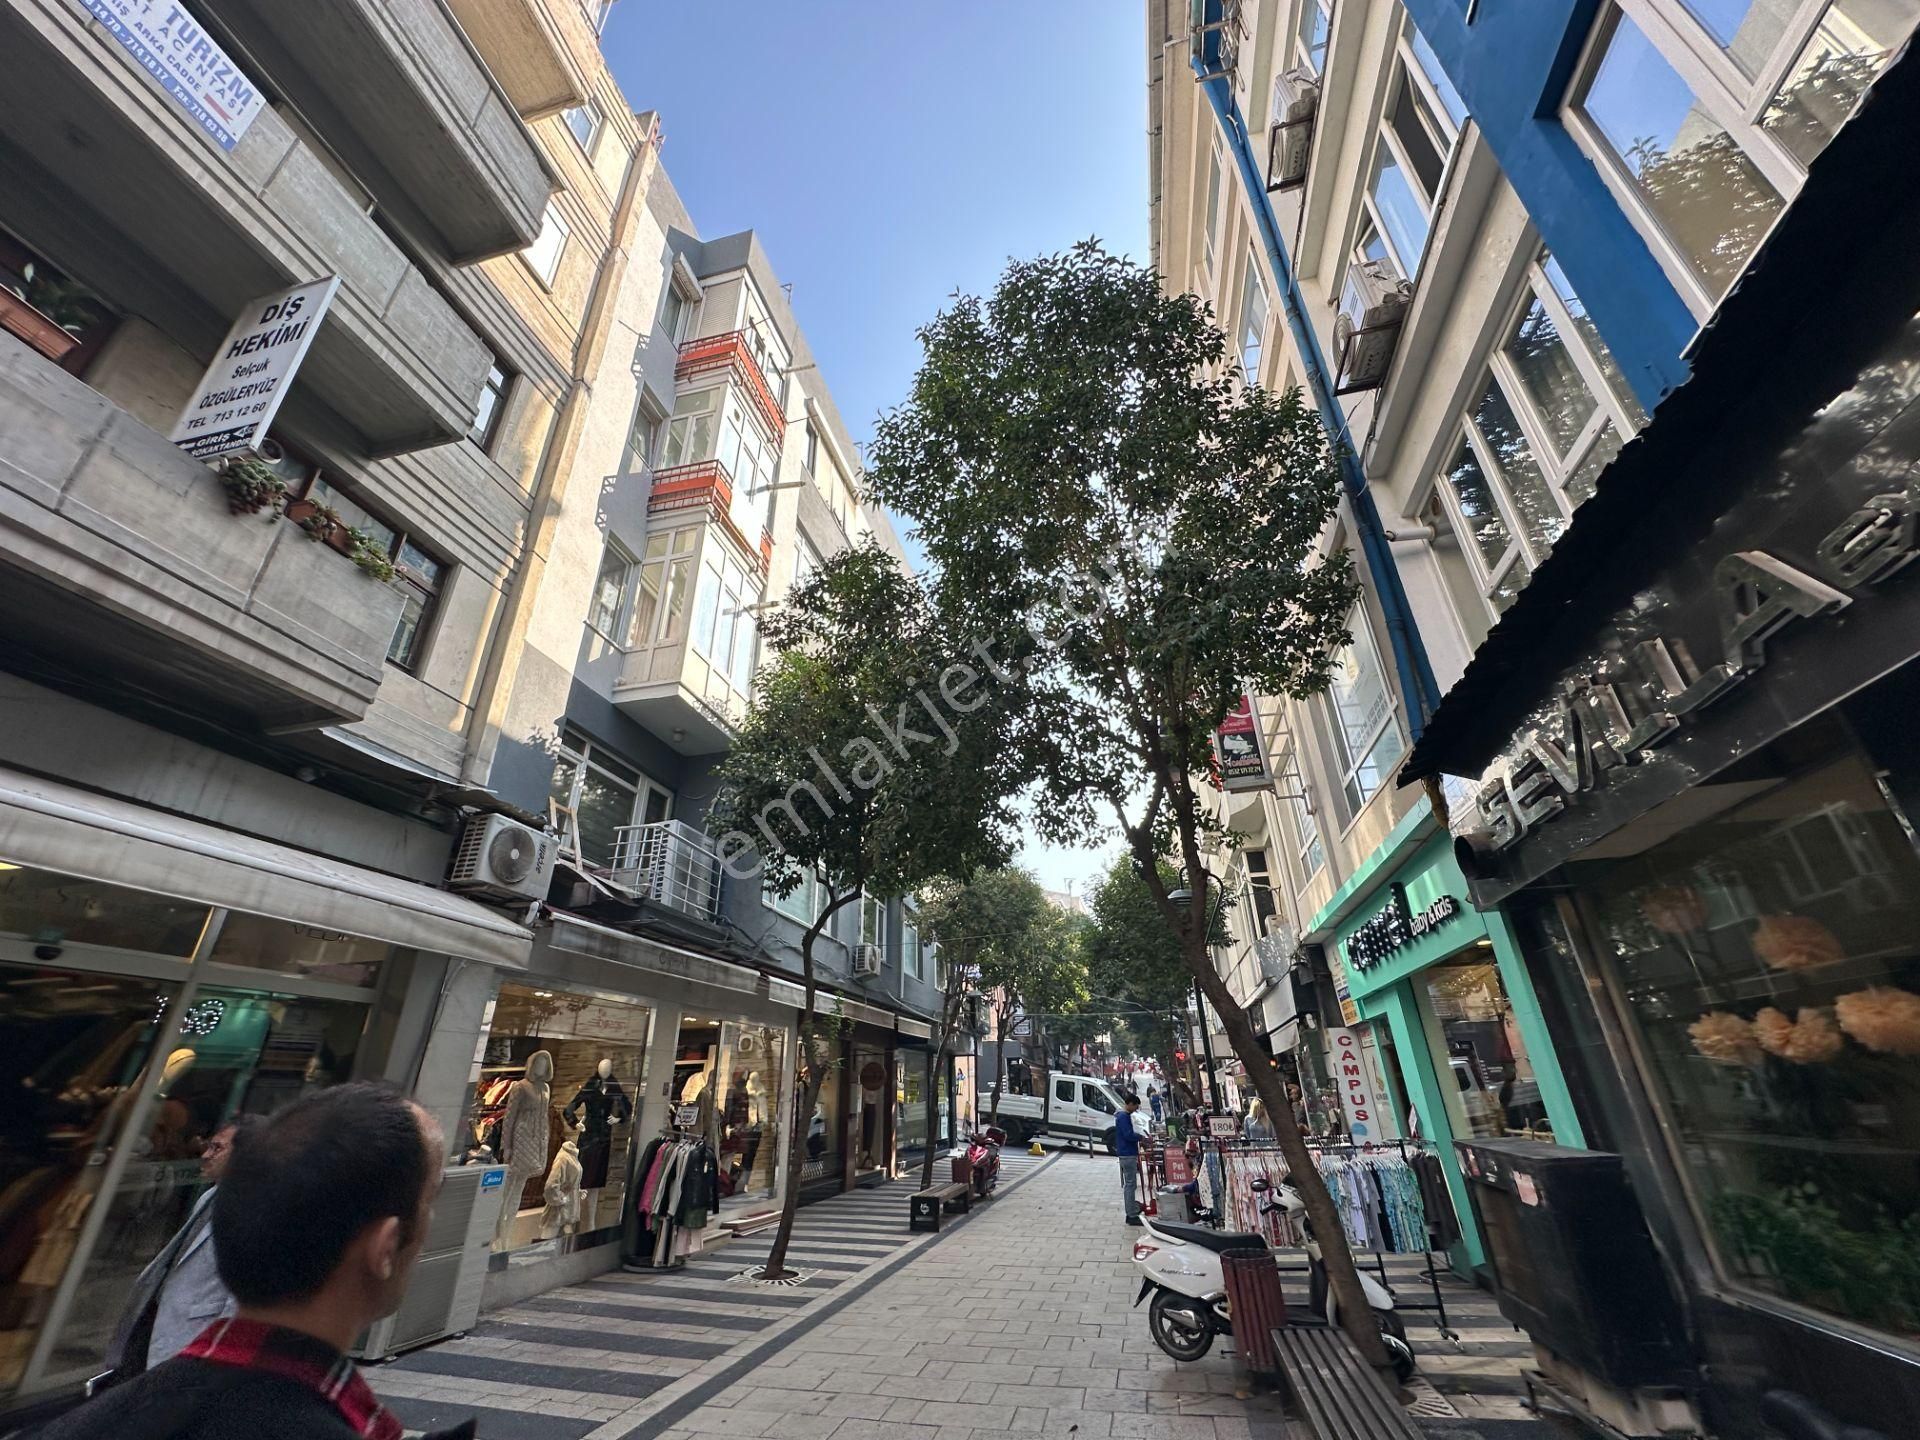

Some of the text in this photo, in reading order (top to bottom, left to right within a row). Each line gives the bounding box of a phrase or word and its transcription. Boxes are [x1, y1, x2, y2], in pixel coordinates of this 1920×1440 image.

[134, 21, 165, 54] ARKA
[166, 54, 202, 92] CADDE
[158, 26, 243, 116] ACENTASI
[125, 36, 145, 61] 714
[173, 83, 191, 107] Fax:
[189, 99, 207, 123] 718
[259, 296, 305, 325] DİŞ
[226, 316, 311, 359] HEKİMİ
[231, 358, 271, 379] Selçuk
[199, 378, 278, 410] ÖZGÜLERYÜZ
[186, 401, 267, 430] TEL 713 12 60
[196, 433, 232, 448] GİRİŞ
[1408, 911, 1430, 937] baby
[1434, 896, 1453, 921] kids
[1337, 1035, 1369, 1121] CAMPUS
